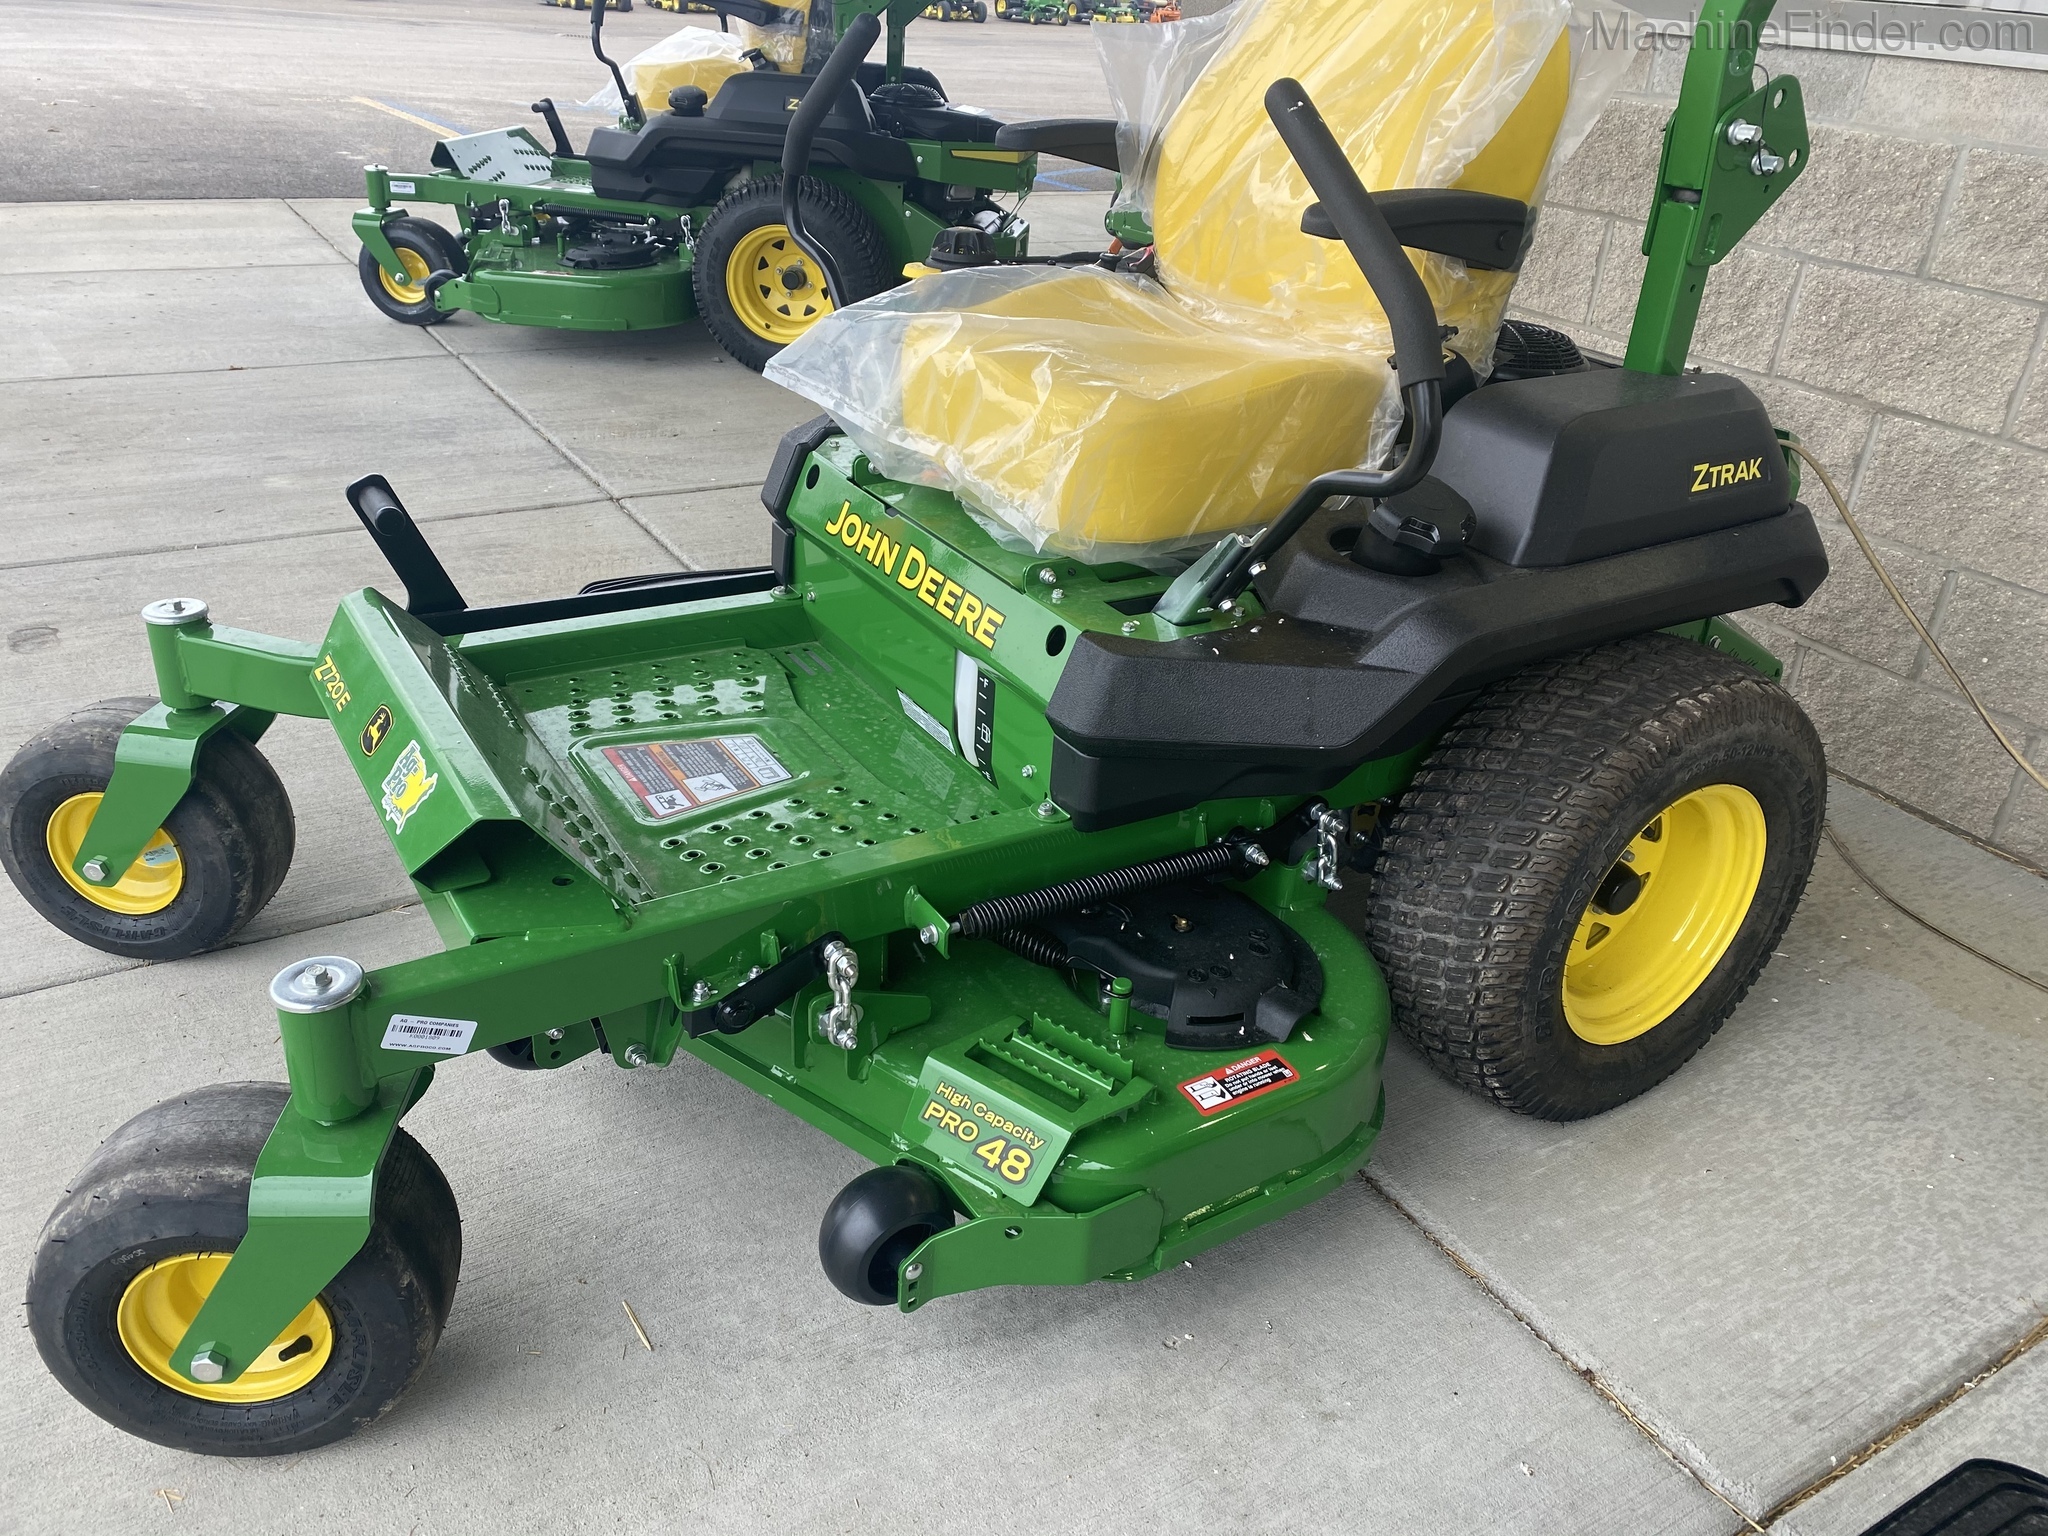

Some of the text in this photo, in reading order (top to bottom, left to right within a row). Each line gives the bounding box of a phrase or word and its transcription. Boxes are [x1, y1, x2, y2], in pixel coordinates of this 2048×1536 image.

[1691, 457, 1763, 492] ZTRAK
[825, 500, 1006, 650] JOHN DEERE
[314, 654, 351, 712] Z720E
[60, 904, 168, 939] CARLISLE
[1534, 827, 1627, 1046] CARLISLE
[429, 1020, 459, 1028] COMPANIES
[1224, 1069, 1253, 1082] ROTATING
[1231, 1057, 1261, 1070] DANGER
[923, 1100, 1034, 1185] PRO 48
[936, 1081, 1047, 1150] High Capacity
[328, 1297, 368, 1412] CARLISLE
